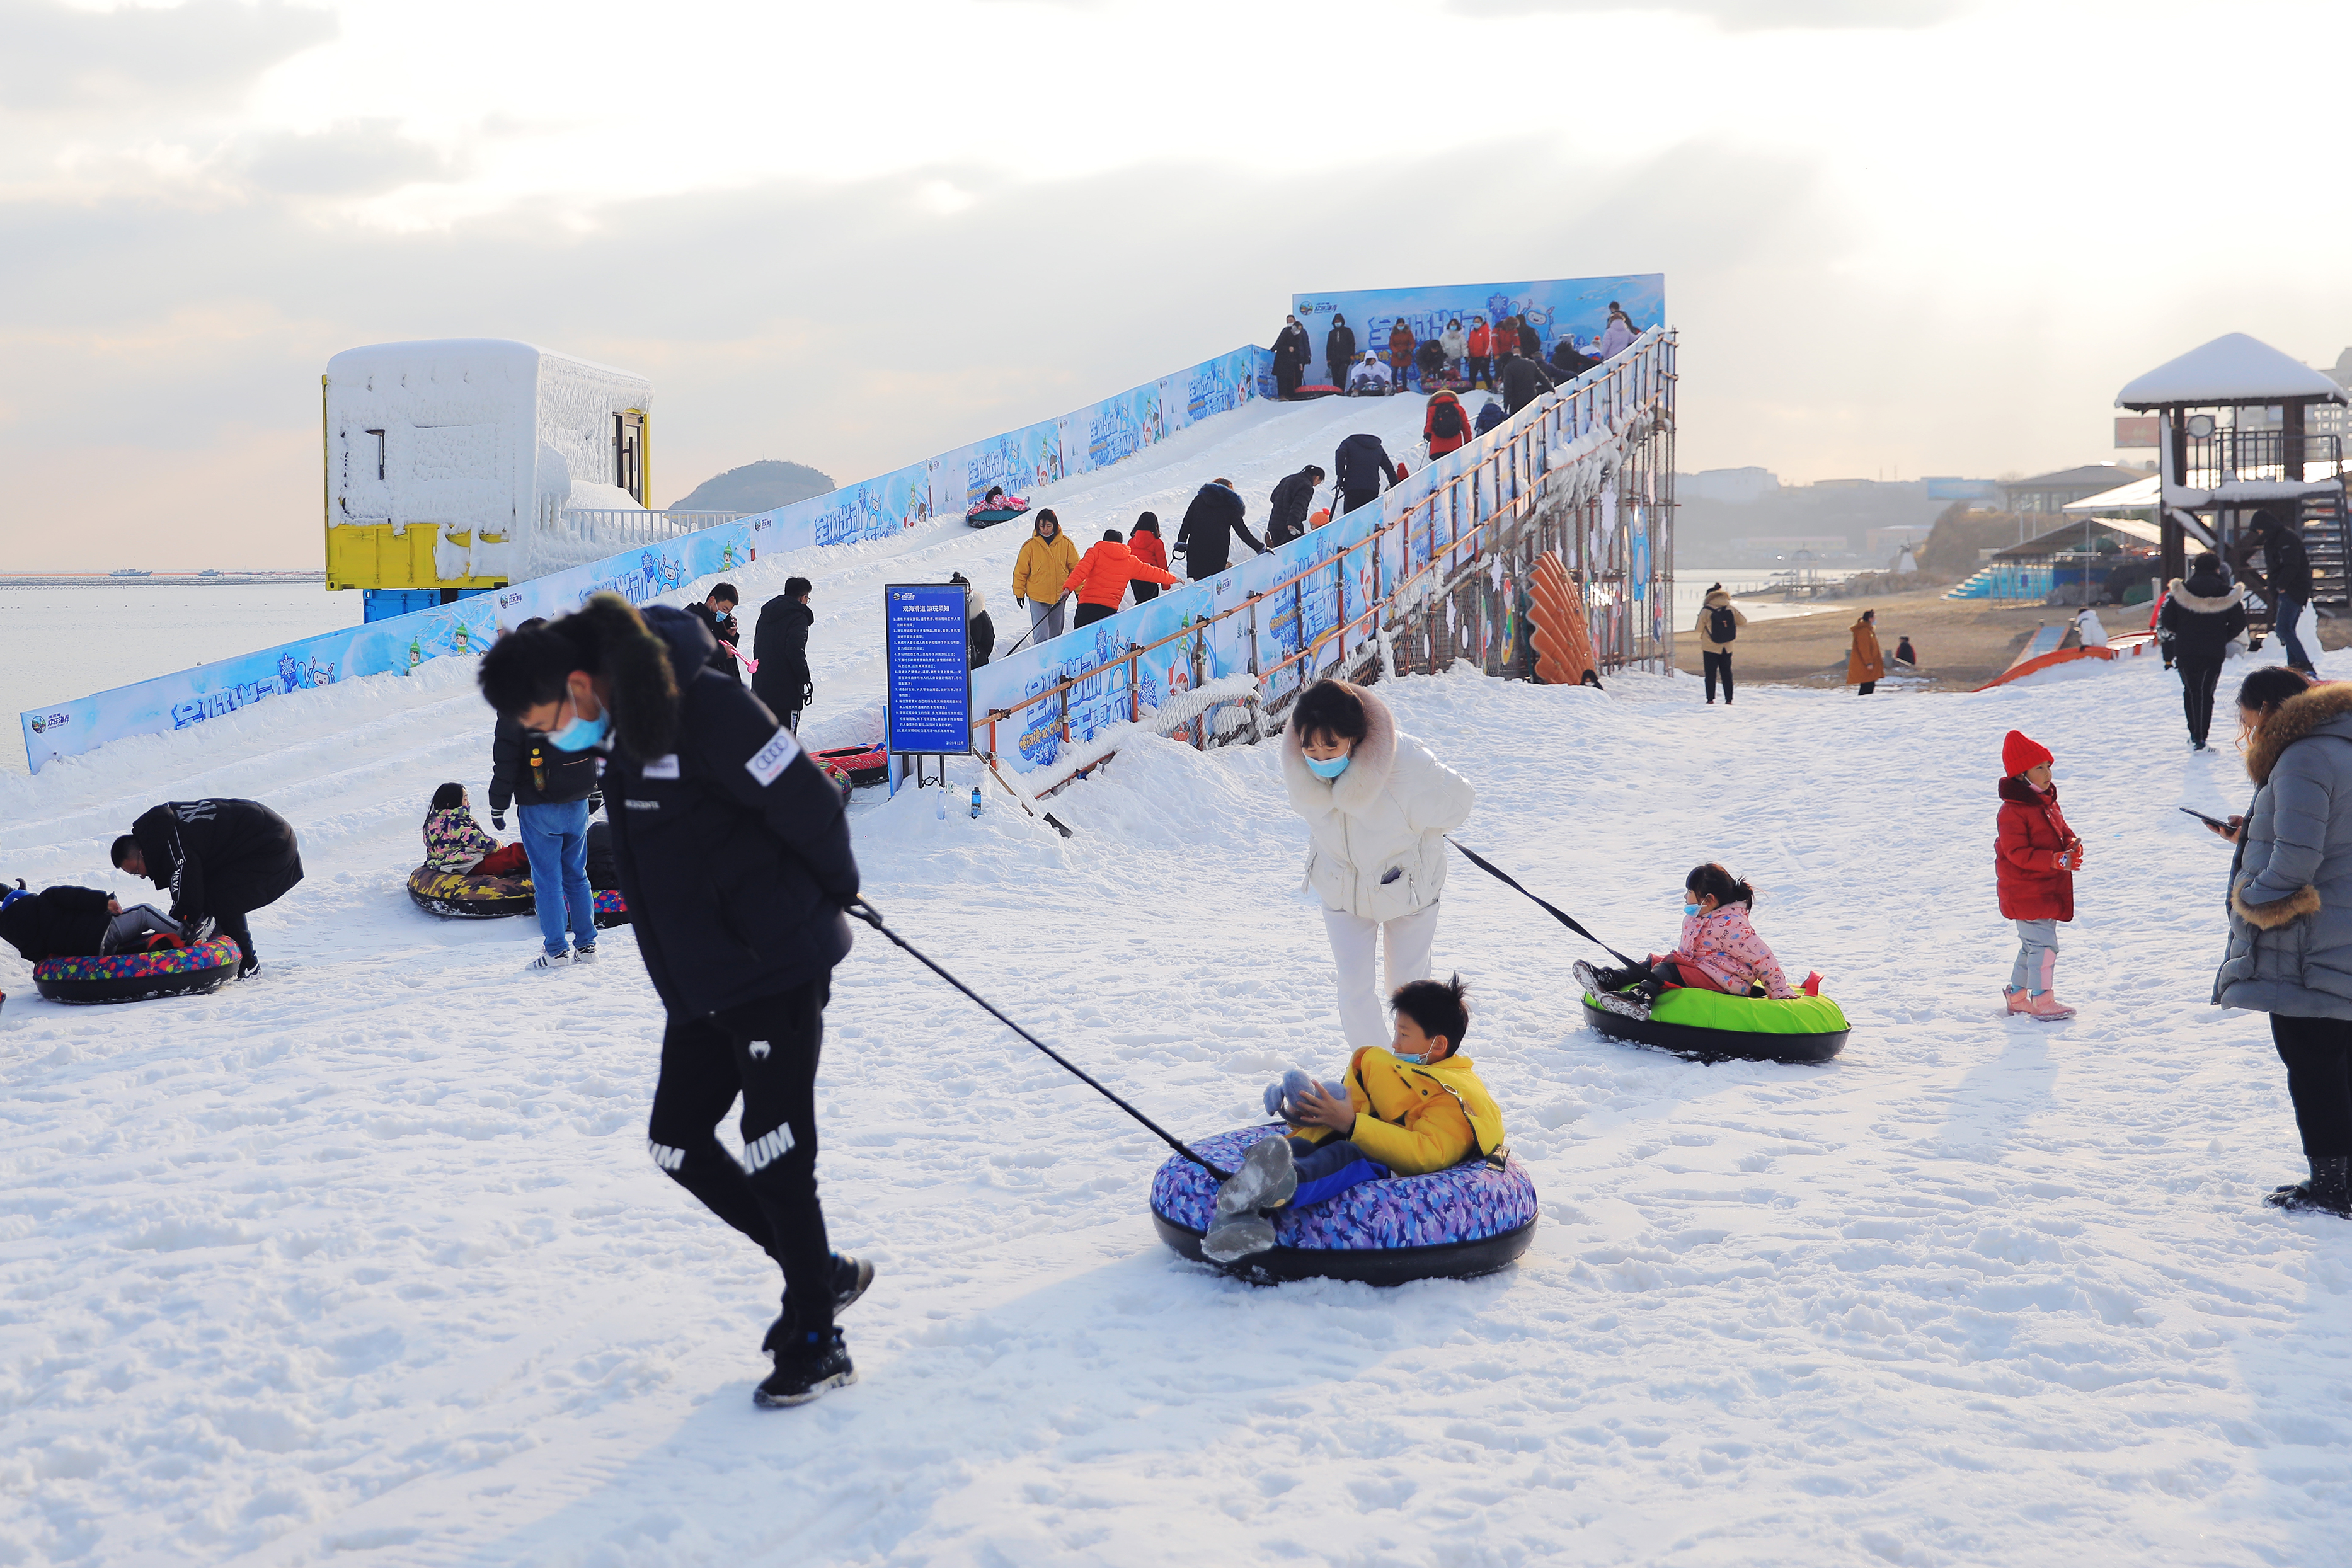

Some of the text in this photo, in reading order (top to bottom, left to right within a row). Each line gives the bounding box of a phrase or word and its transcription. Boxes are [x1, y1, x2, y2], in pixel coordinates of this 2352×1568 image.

[1089, 411, 1118, 443] 全城出动
[968, 449, 1004, 486] 全城出动
[815, 500, 863, 546] 全城出动
[47, 714, 69, 727] 欢乐海岸
[1019, 719, 1061, 752] 塔河湾·欢乐海
